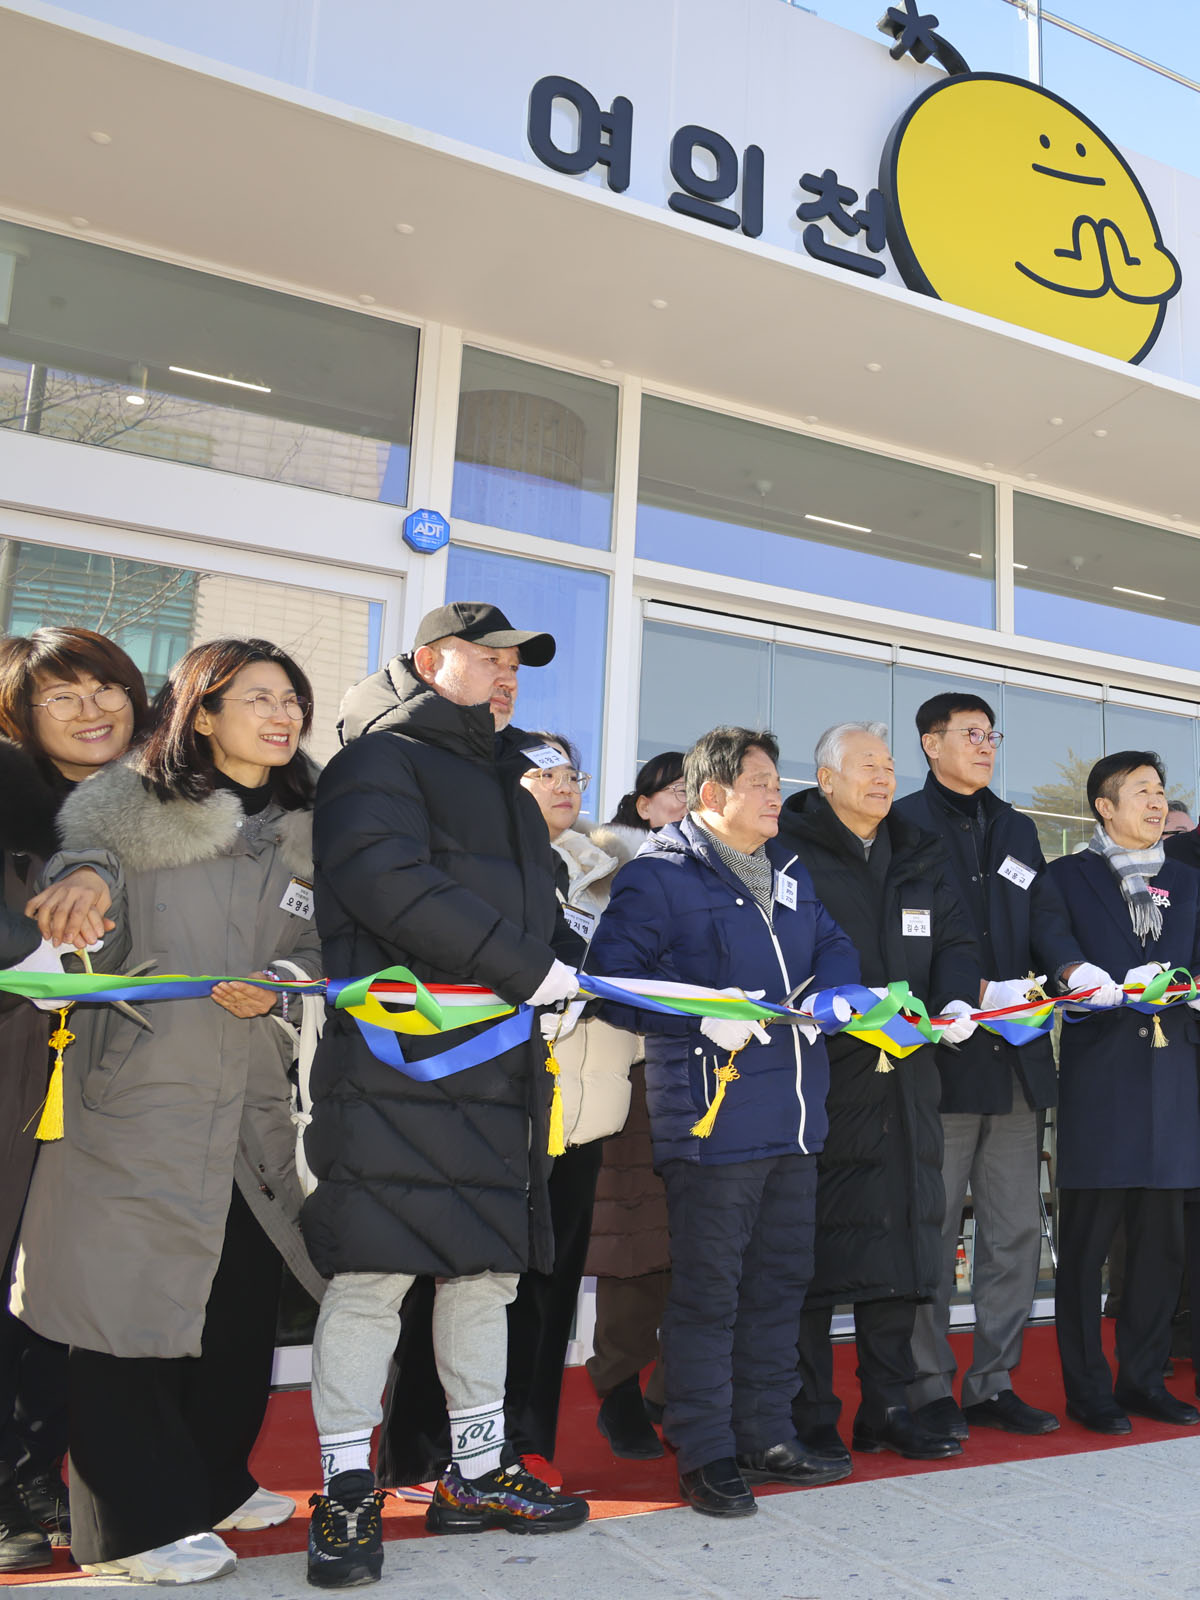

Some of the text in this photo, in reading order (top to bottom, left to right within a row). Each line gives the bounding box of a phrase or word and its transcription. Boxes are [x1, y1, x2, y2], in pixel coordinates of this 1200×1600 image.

[527, 75, 886, 278] 여의천
[414, 521, 444, 538] ADT
[286, 897, 310, 914] 오영숙
[906, 923, 926, 933] 김수진
